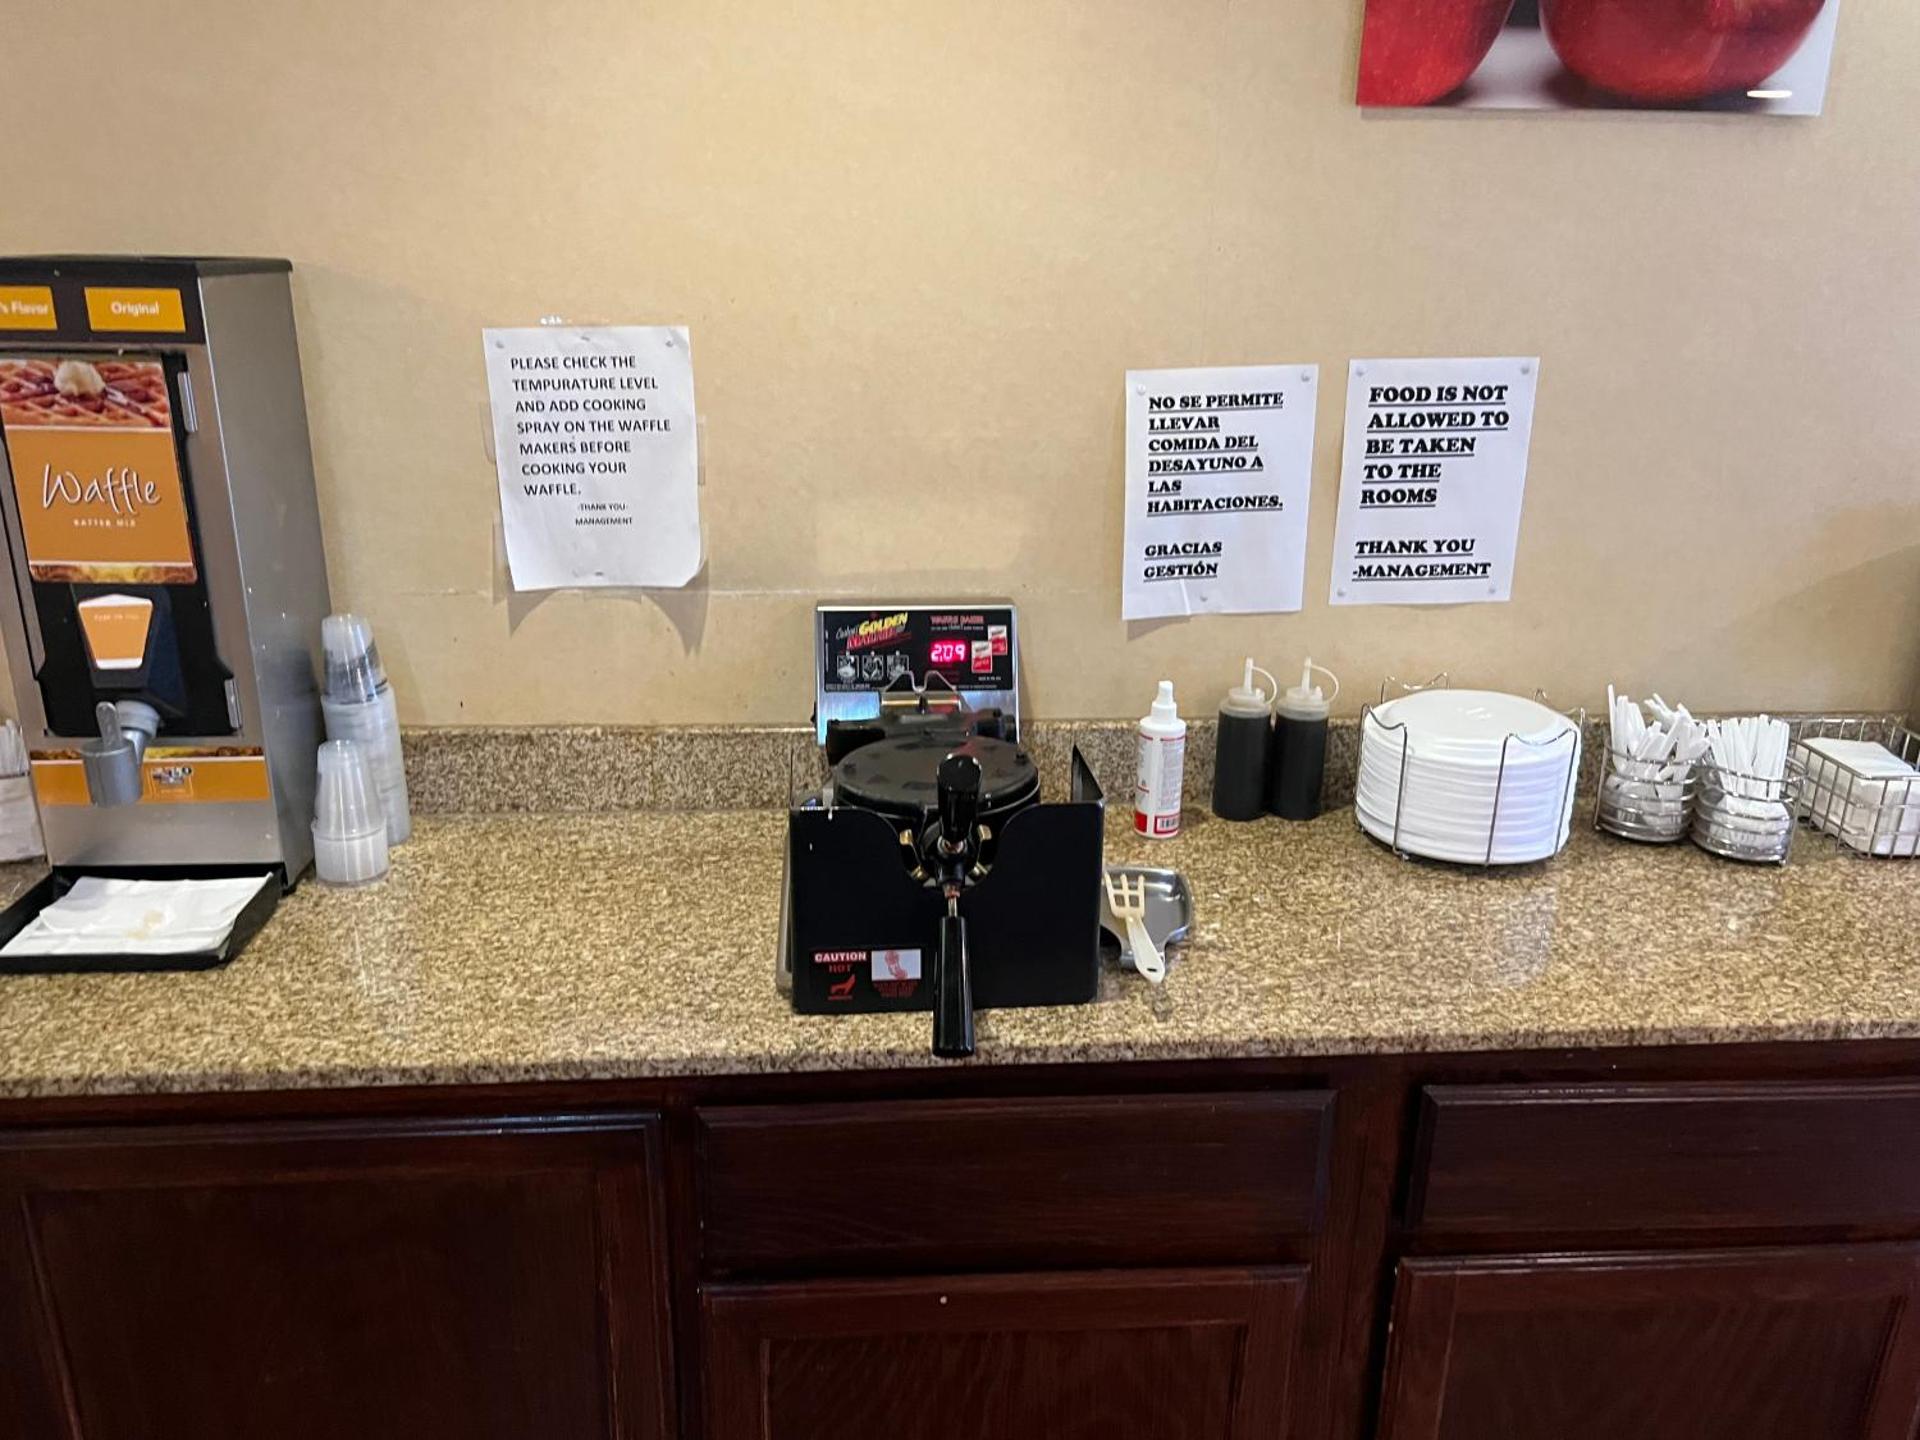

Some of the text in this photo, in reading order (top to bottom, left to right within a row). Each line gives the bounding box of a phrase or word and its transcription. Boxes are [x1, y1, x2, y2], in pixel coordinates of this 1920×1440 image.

[111, 302, 160, 316] Original
[510, 355, 636, 370] PLEASE CHECK THE
[512, 377, 658, 392] TEMPURATURE LEVEL
[1149, 392, 1284, 410] NO SE PERMITE
[1369, 385, 1509, 403] FOOD IS NOT
[515, 398, 646, 413] AND ADD COOKING
[516, 419, 671, 435] SPRAY ON THE WAFFLE
[1149, 416, 1220, 431] LLEVAR
[1367, 411, 1510, 429] ALLOWED TO
[519, 441, 631, 456] MAKERS BEFORE
[1148, 436, 1259, 452] COMIDA DEL
[1365, 437, 1476, 454] BE TAKEN
[521, 461, 628, 476] COOKING YOUR
[1148, 456, 1264, 473] DESAYUNO A
[1363, 463, 1442, 479] TO THE
[40, 463, 162, 515] Waffle
[523, 483, 582, 496] WAFFLE.
[1148, 480, 1182, 493] LAS
[1360, 488, 1438, 504] ROOMS
[1147, 495, 1284, 514] HABITACIONES.
[575, 517, 632, 526] MANAGEMENT
[1145, 542, 1223, 557] GRACIAS
[1355, 538, 1476, 554] THANK YOU
[1144, 561, 1219, 578] GESTIÓN
[1352, 562, 1492, 578] -MANAGEMENT
[814, 951, 867, 963] CAUTION
